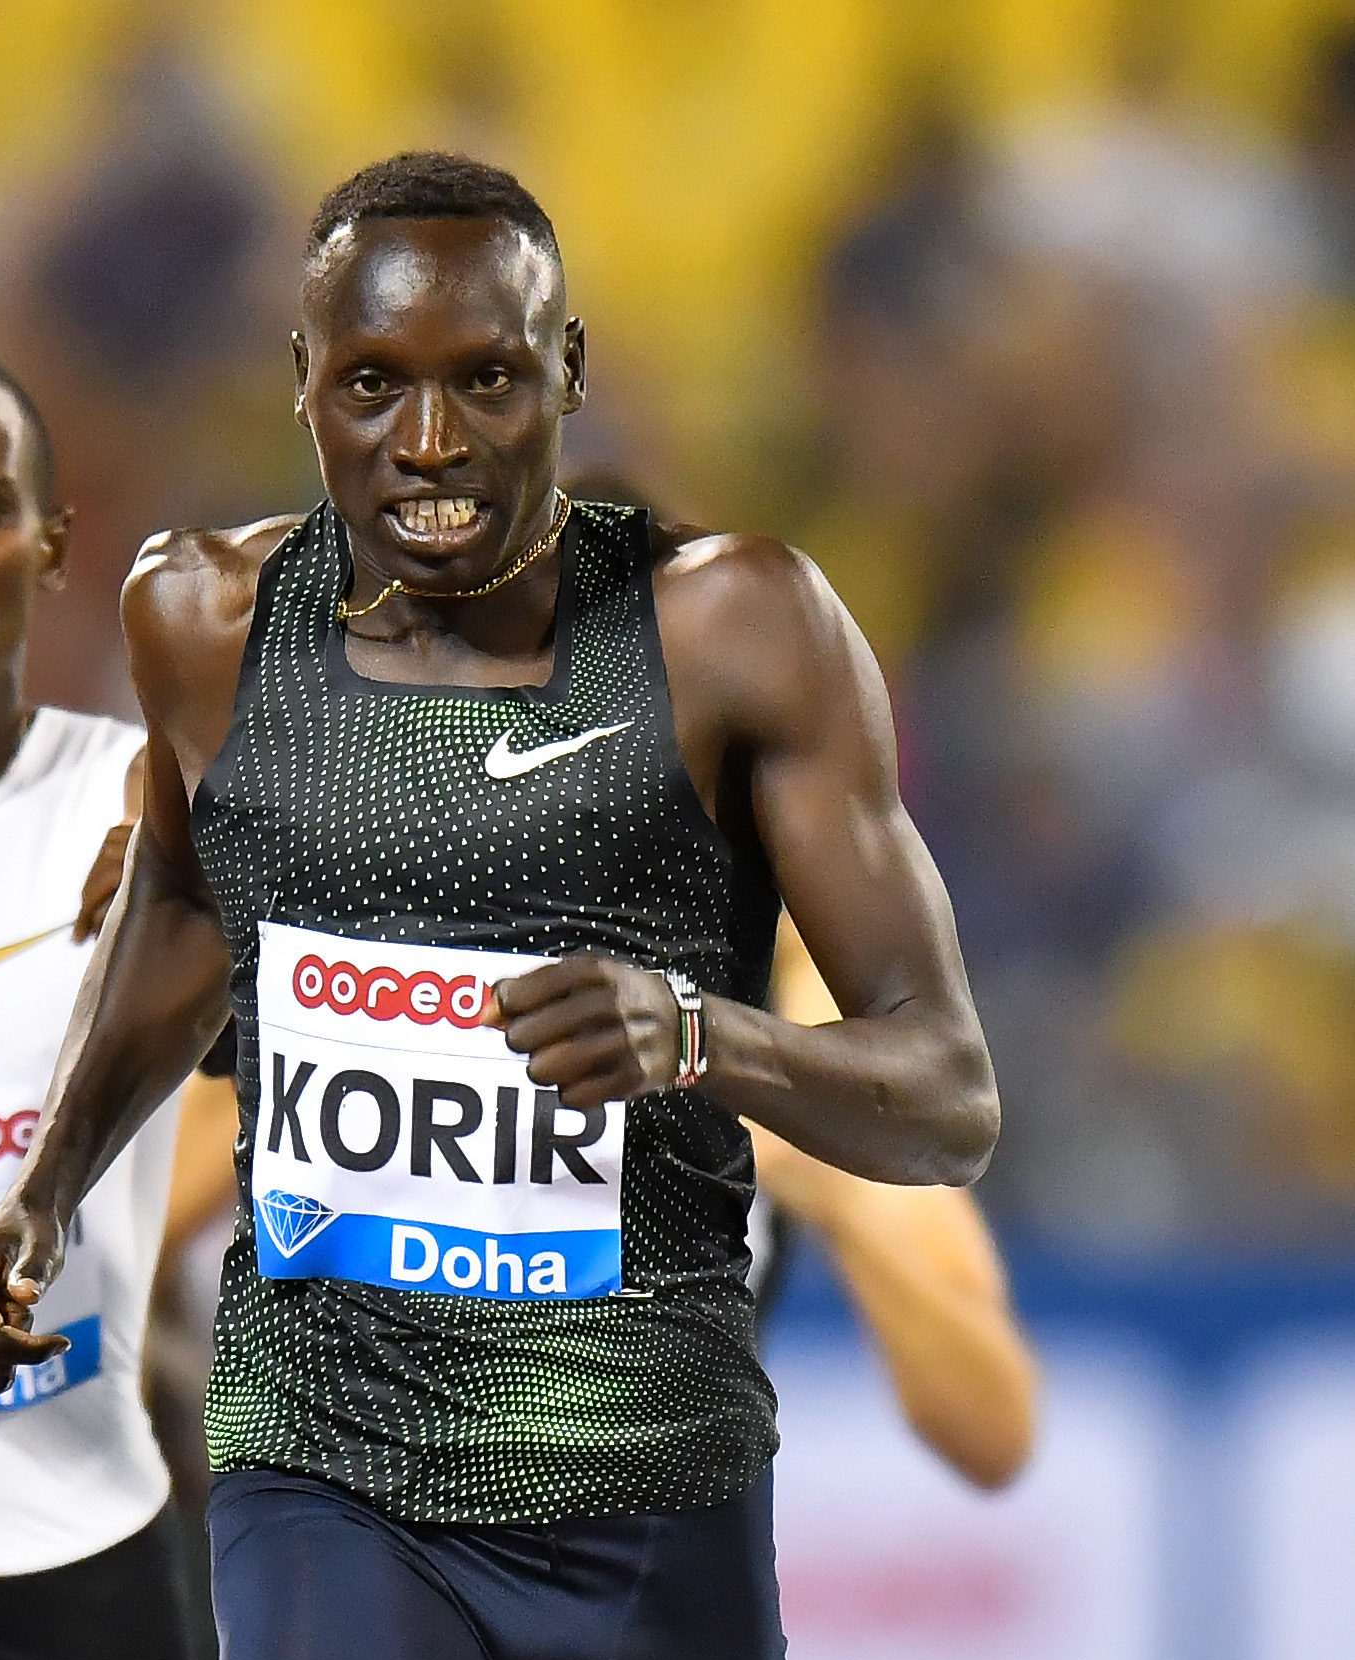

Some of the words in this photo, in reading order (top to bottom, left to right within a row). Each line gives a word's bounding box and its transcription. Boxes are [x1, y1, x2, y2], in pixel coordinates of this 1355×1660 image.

[293, 954, 496, 1030] oored
[267, 1052, 609, 1186] KORIR
[389, 1223, 567, 1295] Doha
